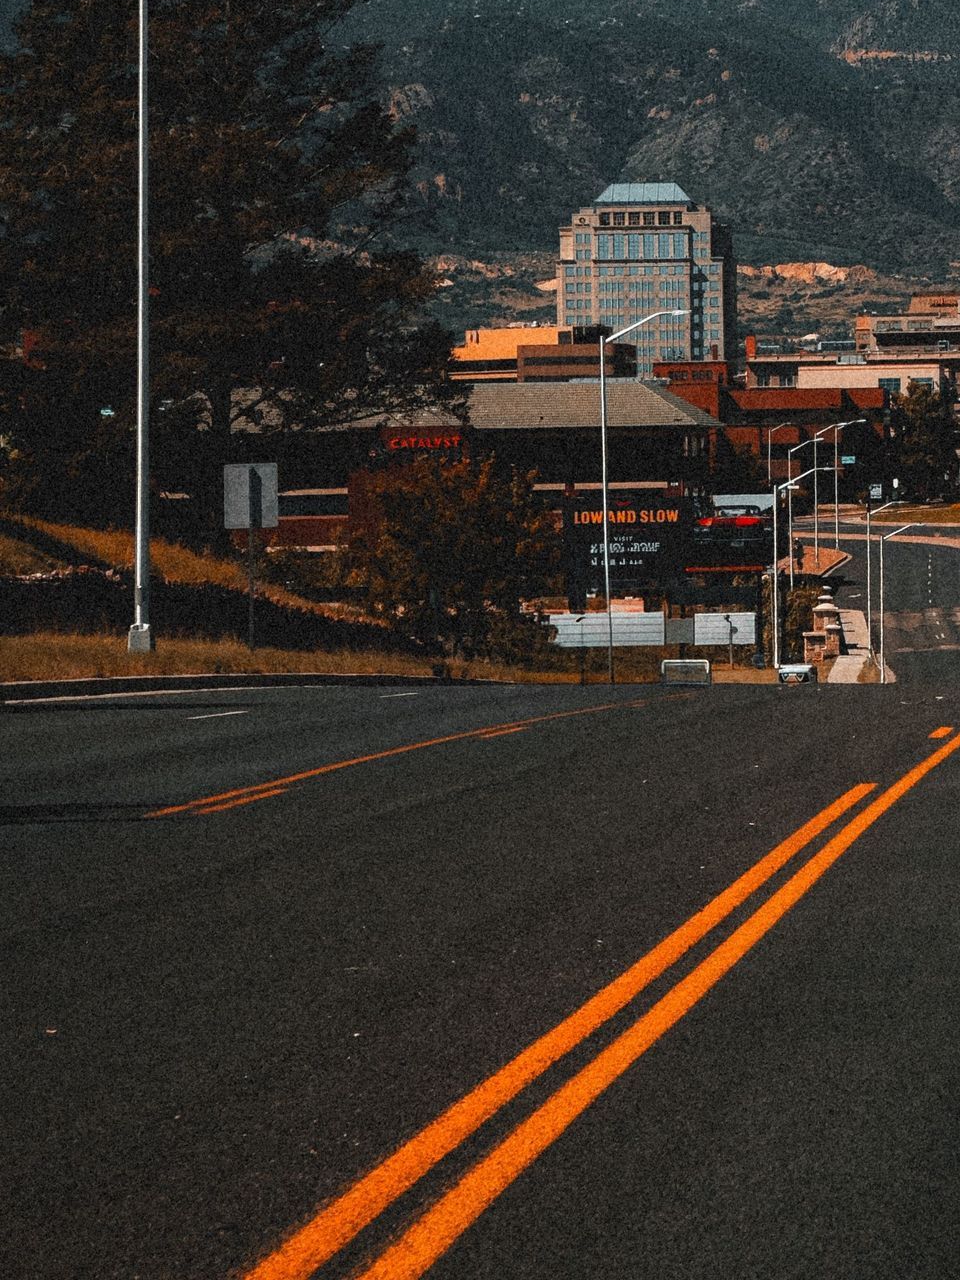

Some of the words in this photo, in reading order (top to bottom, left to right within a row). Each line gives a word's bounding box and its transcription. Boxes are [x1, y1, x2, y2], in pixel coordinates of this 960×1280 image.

[389, 435, 461, 449] CATALYST
[574, 511, 603, 524] LOW
[608, 510, 636, 523] AND
[639, 509, 678, 523] SLOW
